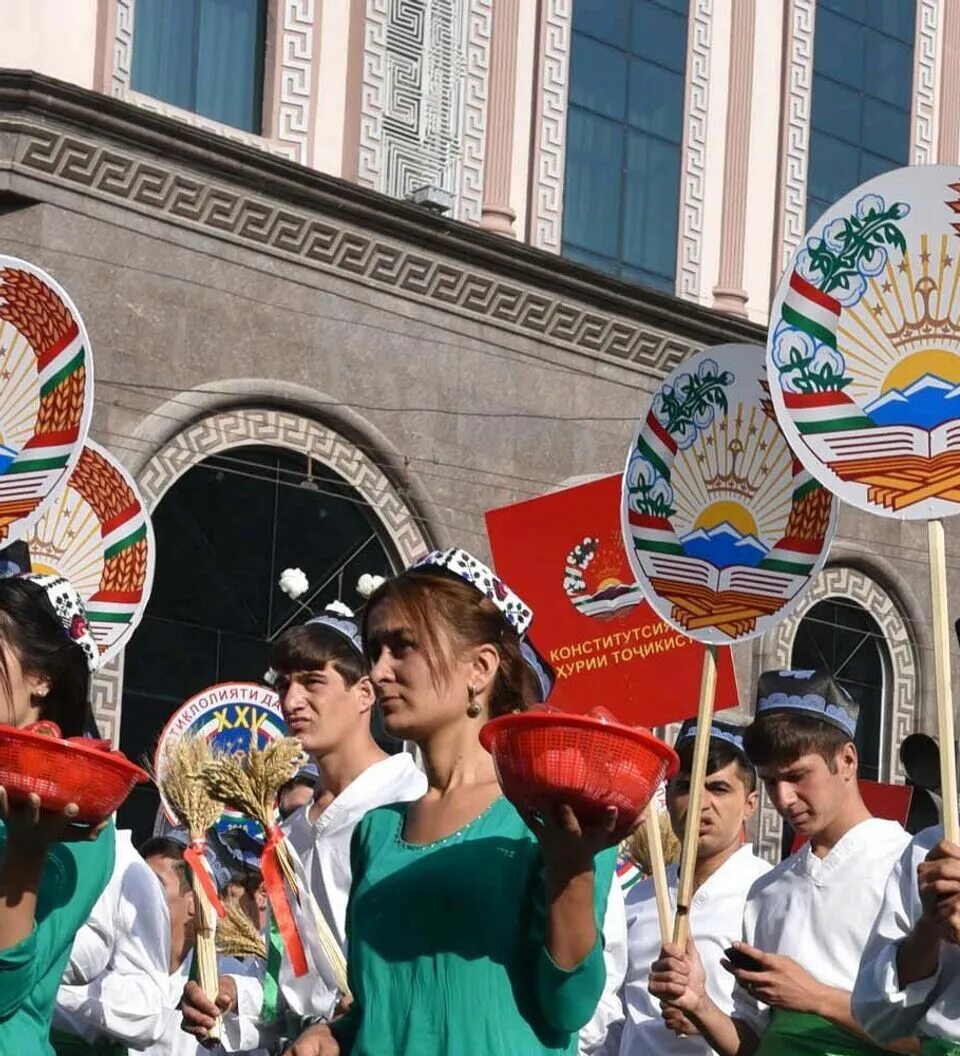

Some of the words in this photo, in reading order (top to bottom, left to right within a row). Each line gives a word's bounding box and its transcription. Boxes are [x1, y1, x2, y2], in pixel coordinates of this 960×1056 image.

[549, 622, 676, 662] КОНСТИТУТСИЯ
[555, 655, 609, 680] ҲУРИИ
[168, 687, 259, 737] ТИКЛОЛИЯТИ
[260, 693, 281, 711] ДА
[213, 705, 268, 732] XXV
